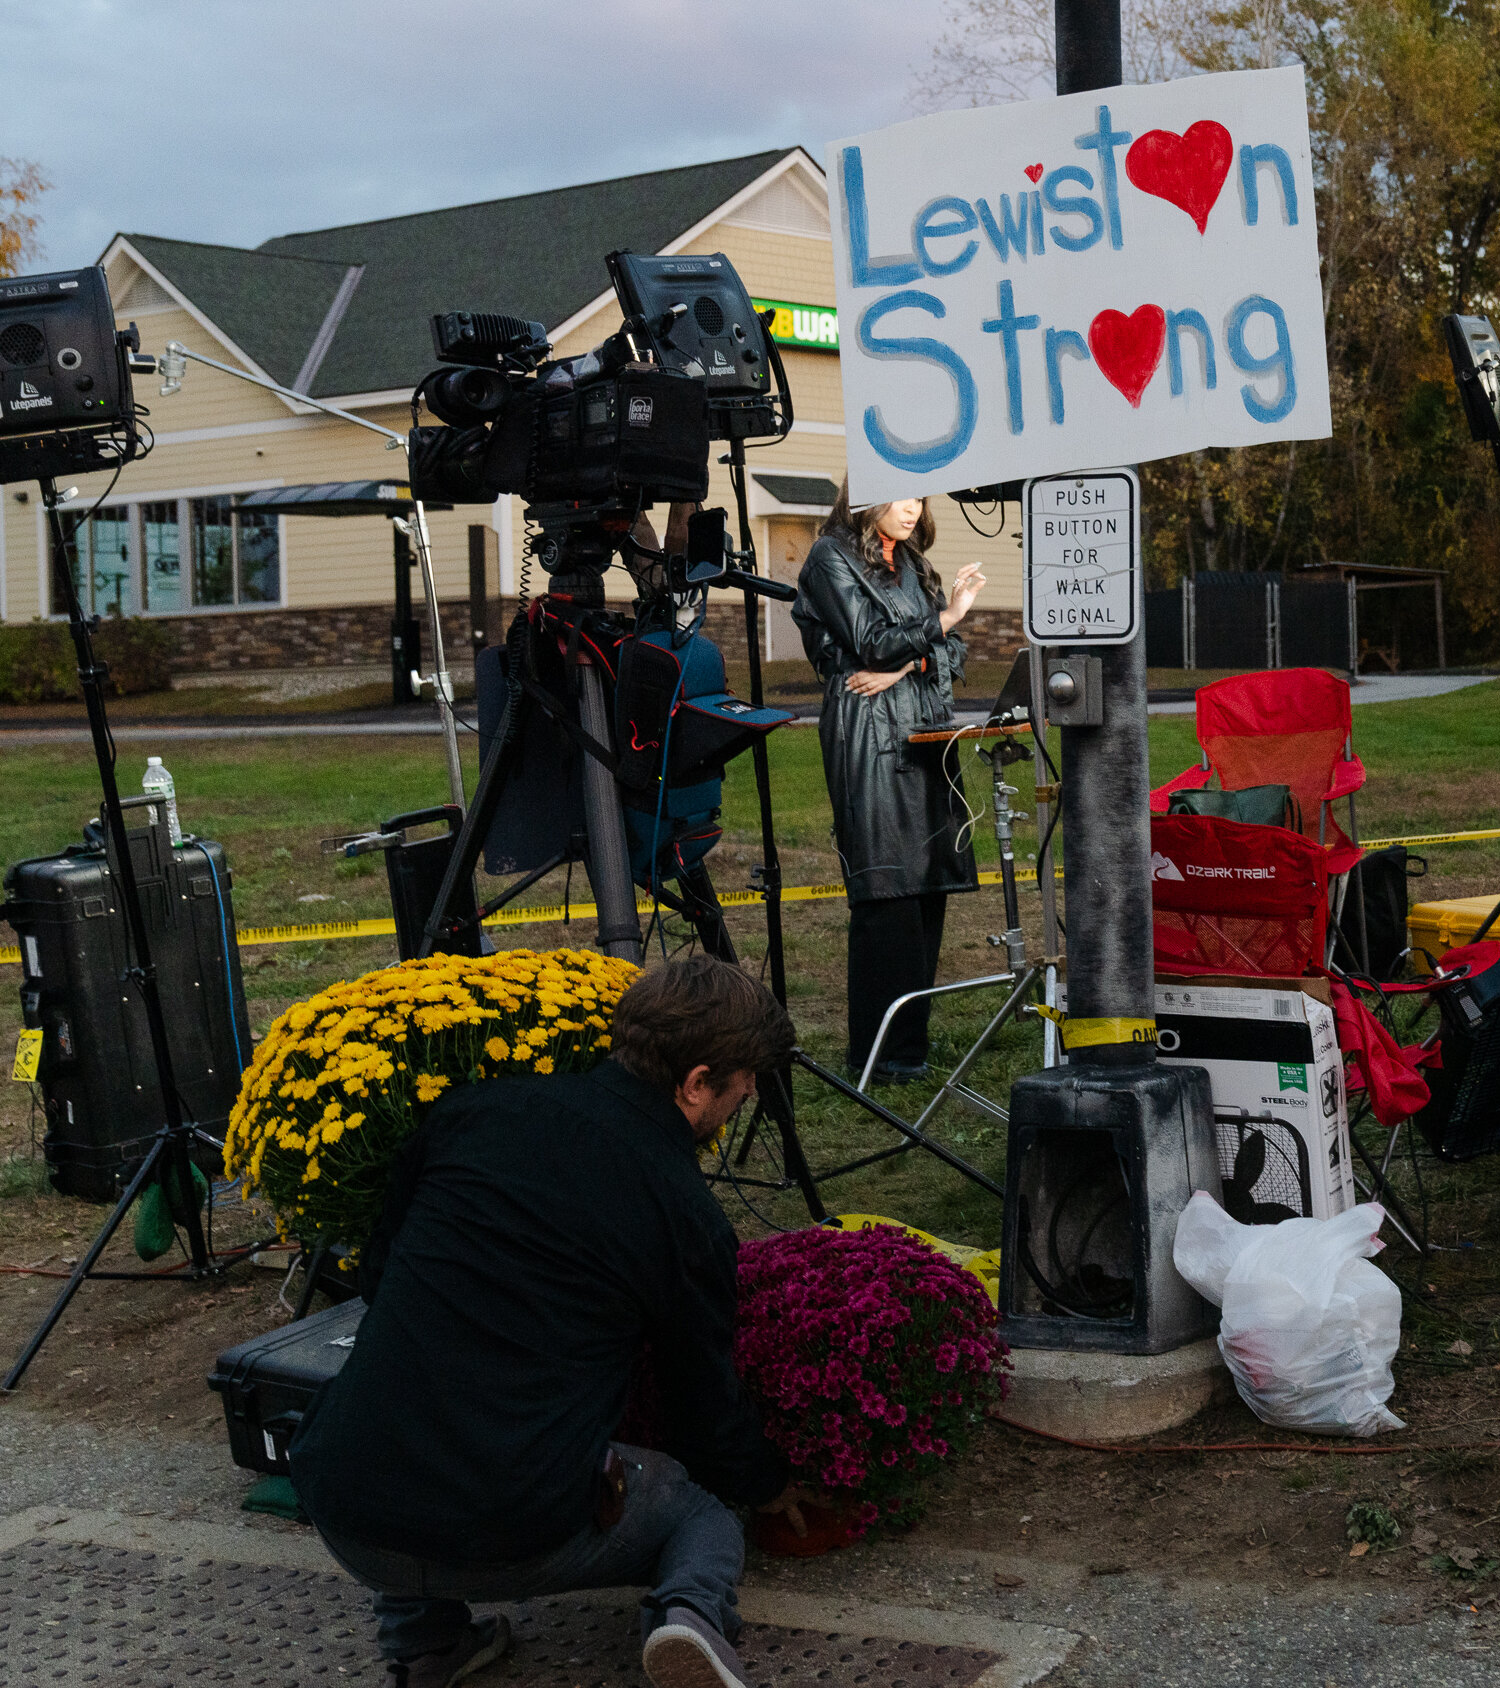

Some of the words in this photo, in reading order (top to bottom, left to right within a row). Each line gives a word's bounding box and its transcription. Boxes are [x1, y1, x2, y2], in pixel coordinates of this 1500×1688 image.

[753, 303, 839, 344] BWA
[10, 396, 53, 411] Litepanels
[1056, 489, 1105, 506] PUSH
[1045, 519, 1117, 537] BUTTON
[1063, 549, 1098, 564] FOR
[1056, 579, 1105, 595] WALK
[1047, 608, 1115, 624] SIGNAL
[1186, 864, 1233, 879] OZARK
[1261, 1096, 1289, 1105] STEEL
[1289, 1098, 1308, 1107] Body
